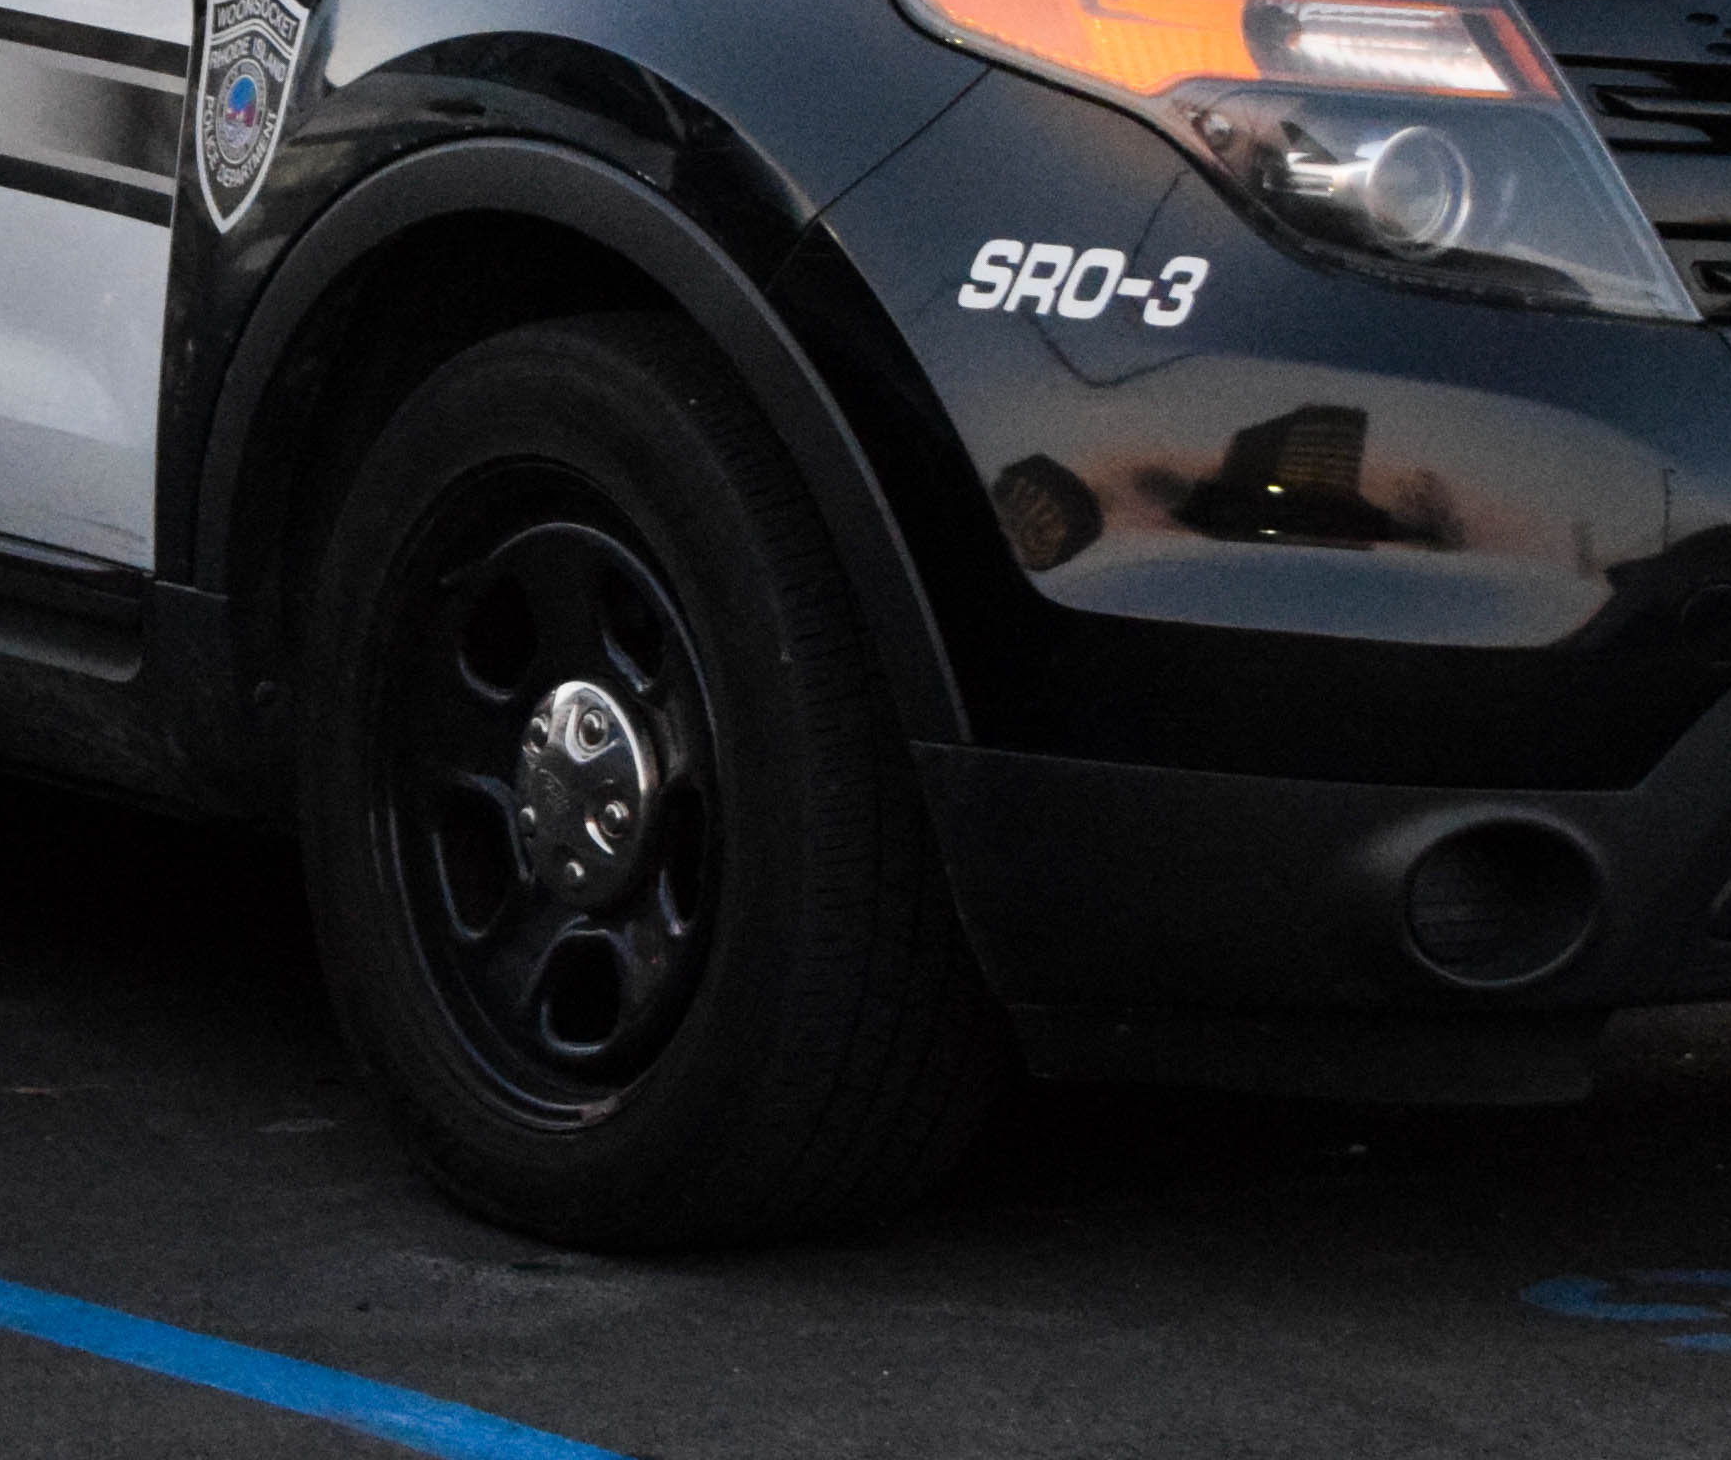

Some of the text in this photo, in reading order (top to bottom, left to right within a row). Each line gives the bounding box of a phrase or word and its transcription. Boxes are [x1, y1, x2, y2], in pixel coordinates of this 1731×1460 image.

[209, 36, 287, 82] RHODE ISLAND
[957, 239, 1210, 327] SRO-3
